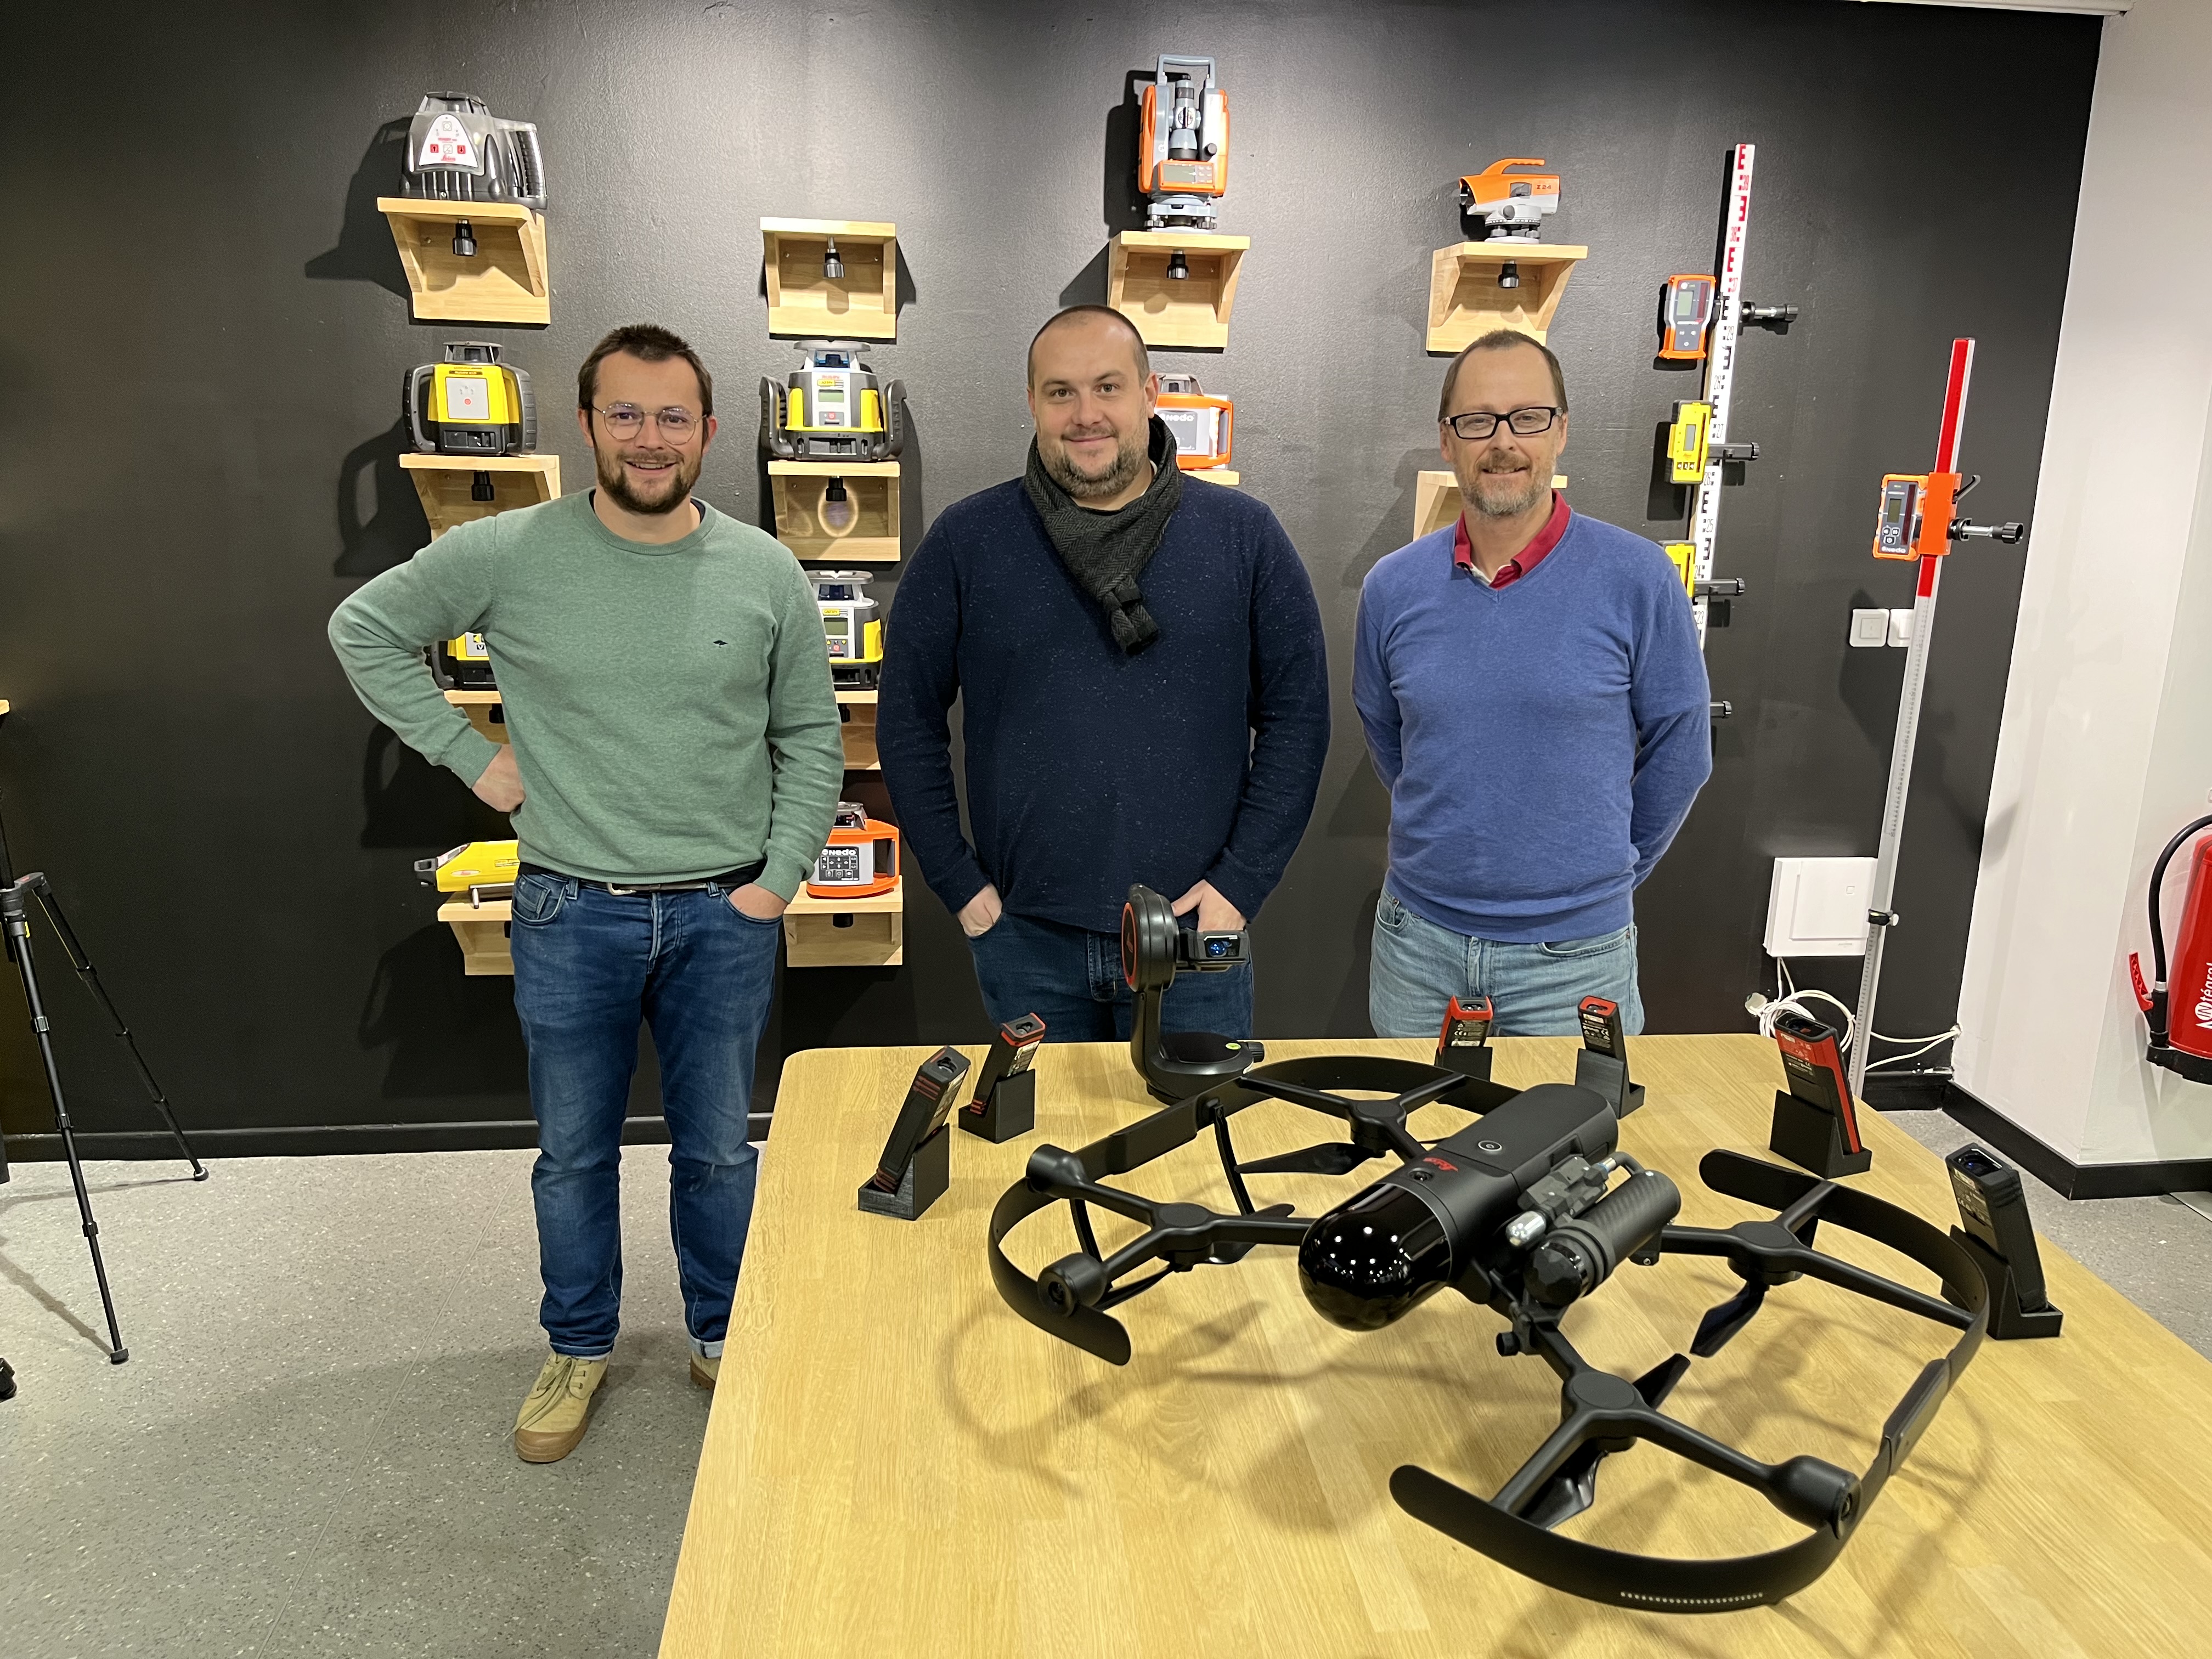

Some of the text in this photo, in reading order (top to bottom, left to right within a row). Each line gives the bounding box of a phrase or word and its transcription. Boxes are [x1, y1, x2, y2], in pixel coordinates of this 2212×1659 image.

[1726, 325, 1734, 341] 29
[1713, 375, 1722, 390] 28
[1716, 423, 1724, 438] 27
[1703, 471, 1712, 486] 26
[1706, 518, 1714, 533] 25
[1694, 565, 1702, 579] 24
[1696, 611, 1704, 625] 23
